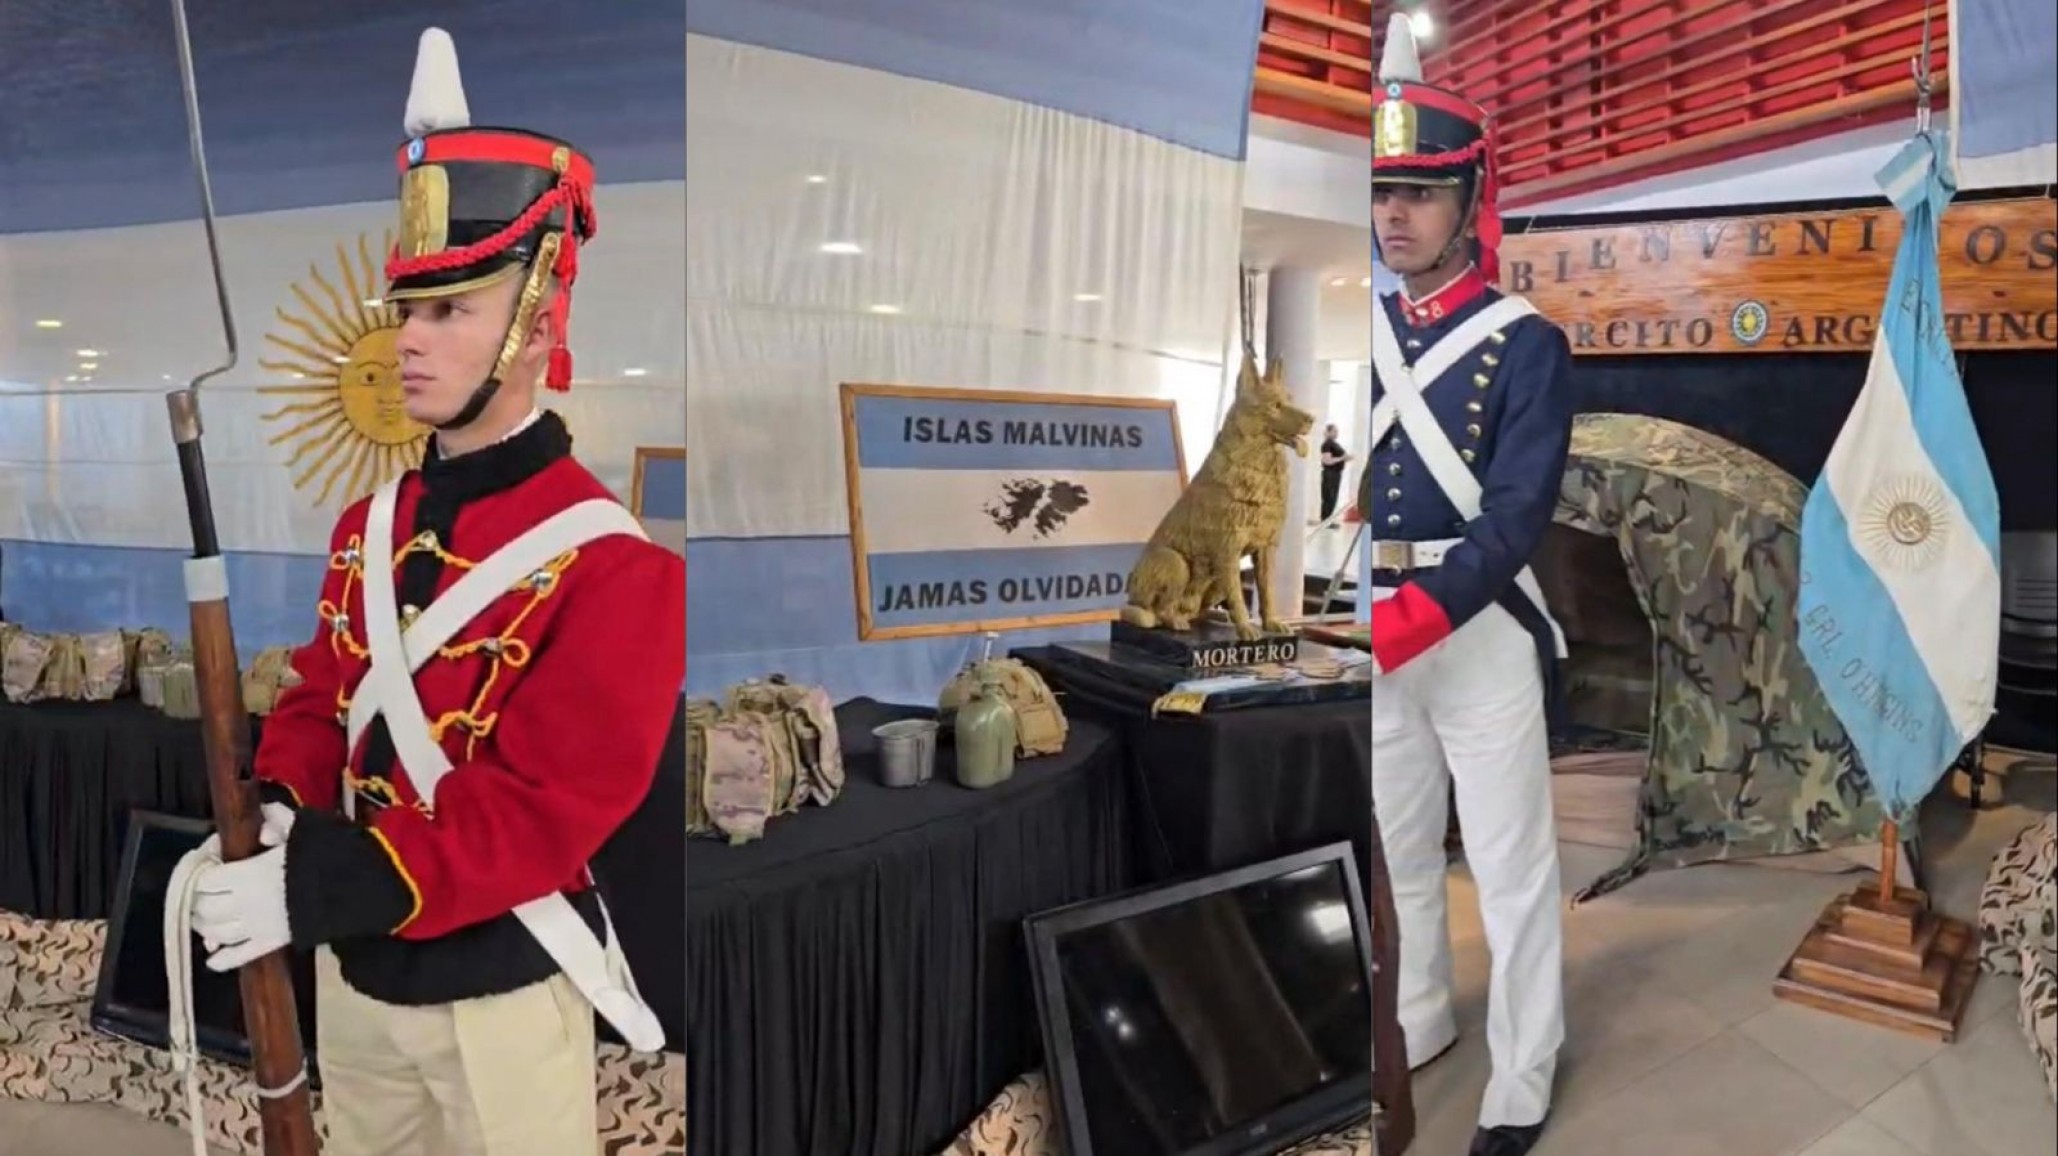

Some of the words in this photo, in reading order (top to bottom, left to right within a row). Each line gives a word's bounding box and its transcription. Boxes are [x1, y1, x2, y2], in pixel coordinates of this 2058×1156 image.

[1509, 214, 2057, 293] BIENVENIOS
[1430, 300, 1443, 318] 8
[1783, 310, 2057, 348] ARGTINO
[903, 416, 993, 445] ISLAS
[1003, 420, 1143, 448] MALVINAS
[878, 580, 988, 613] JAMAS
[1192, 642, 1295, 668] MORTERO
